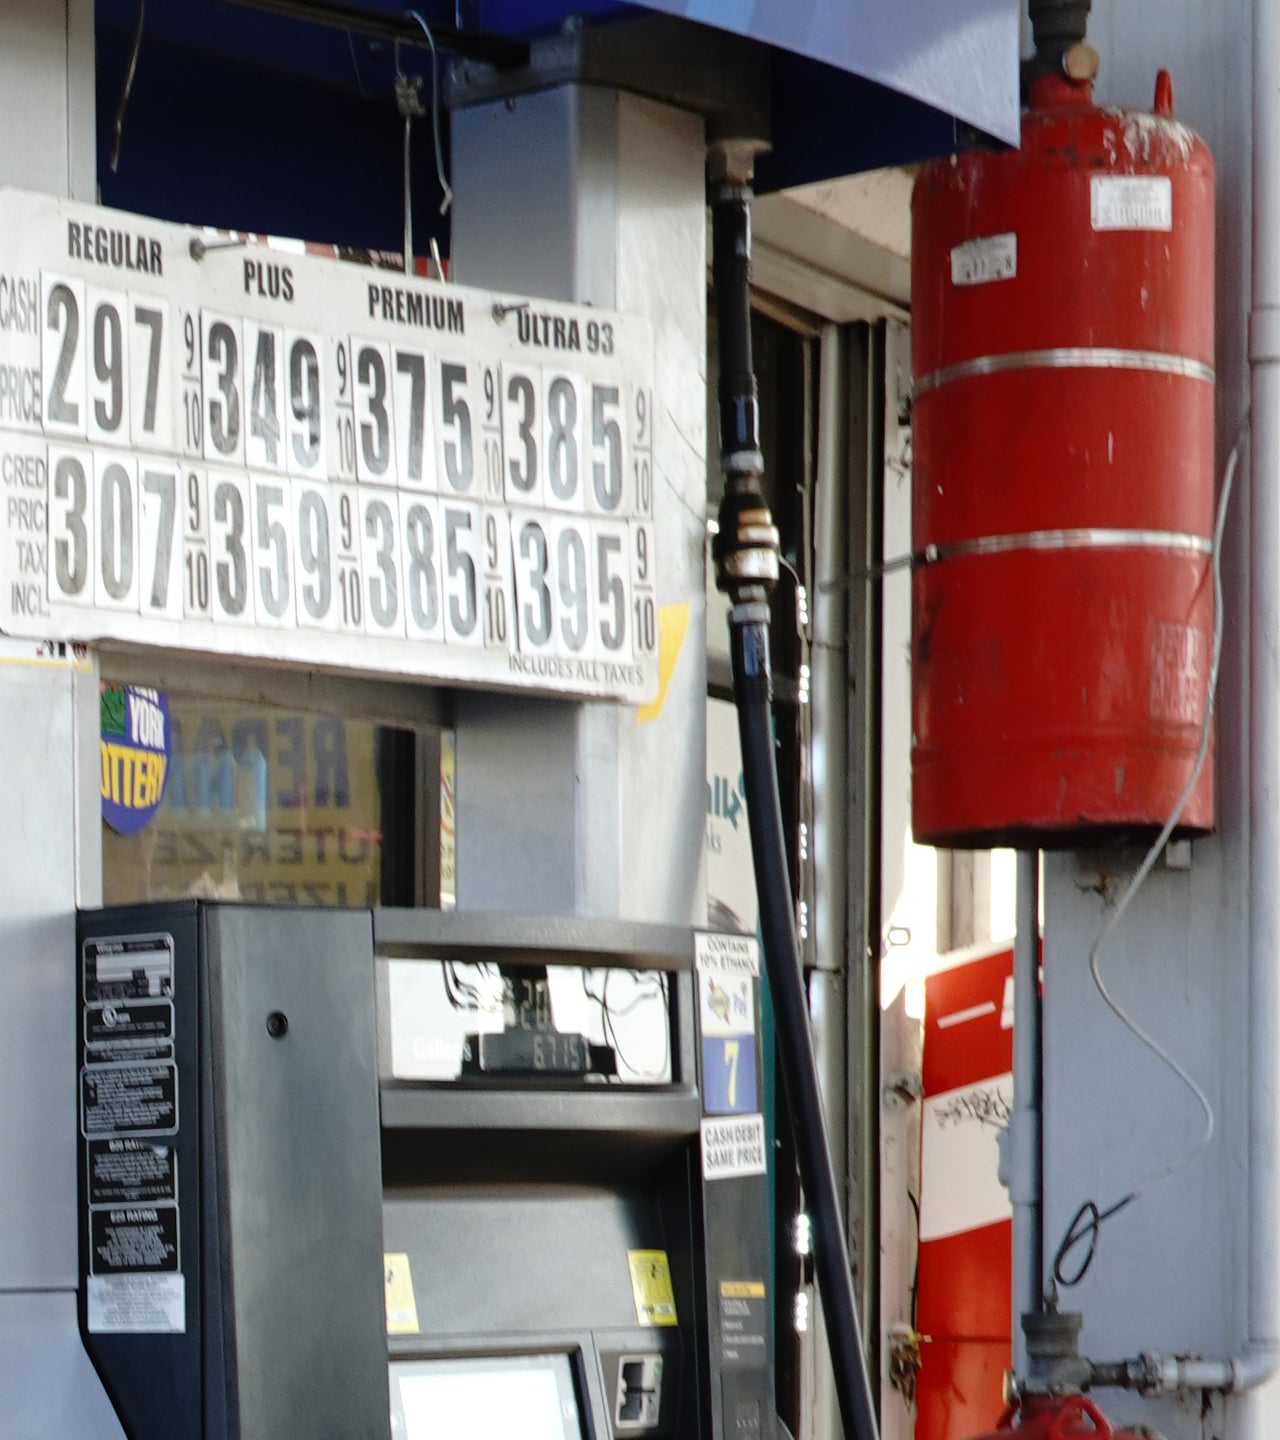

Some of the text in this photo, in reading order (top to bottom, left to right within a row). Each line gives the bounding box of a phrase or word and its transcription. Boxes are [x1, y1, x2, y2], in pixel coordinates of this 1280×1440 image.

[66, 219, 164, 276] REGULAR
[243, 257, 295, 302] PLUS
[367, 282, 466, 335] PREMIUM
[516, 308, 615, 356] ULTRA 93
[46, 279, 165, 436] 297
[208, 320, 322, 469] 349
[357, 346, 475, 493] 375
[1, 453, 46, 490] CRED
[507, 375, 623, 512] 385
[7, 494, 47, 534] PRIC
[54, 455, 178, 609] 307
[214, 481, 333, 620] 359
[364, 497, 477, 637] 385
[519, 520, 627, 652] 395
[507, 655, 645, 688] INCLUDES ALL TAXES
[128, 692, 167, 752] YORK
[100, 745, 169, 811] OTTERY
[723, 1038, 740, 1109] 7
